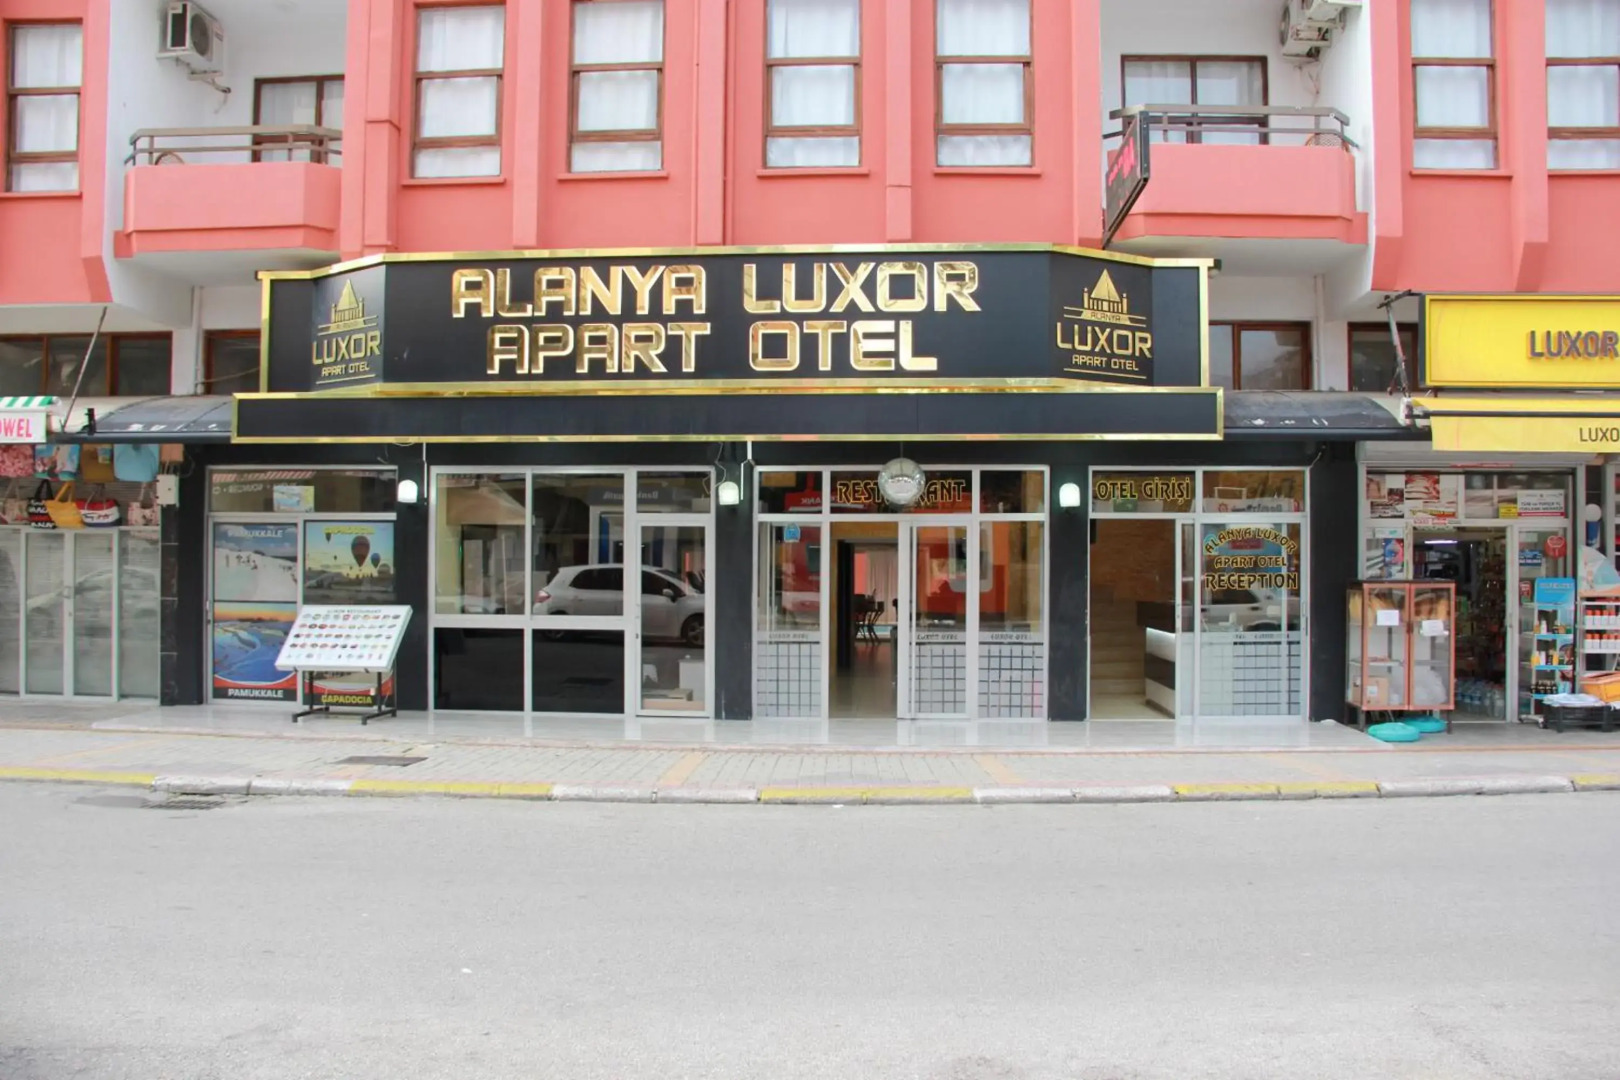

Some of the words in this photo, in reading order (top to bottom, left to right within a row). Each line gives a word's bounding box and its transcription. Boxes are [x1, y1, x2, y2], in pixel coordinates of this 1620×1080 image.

[452, 264, 706, 318] ALANYA
[743, 261, 982, 314] LUXOR
[312, 330, 381, 365] LUXOR
[486, 322, 711, 375] APART
[749, 320, 938, 371] OTEL
[1056, 322, 1152, 358] LUXOR
[1529, 330, 1620, 357] LUXOR
[321, 364, 346, 377] APART
[348, 361, 370, 374] OTEL
[1072, 354, 1108, 368] APART
[1110, 358, 1139, 371] OTEL
[836, 479, 966, 505] RESTANT
[1096, 480, 1138, 500] OTEL
[1141, 477, 1191, 505] GİRİŞİ
[1203, 527, 1252, 554] ALANYA
[1255, 527, 1298, 554] LUXOR
[1214, 555, 1256, 569] APART
[1257, 555, 1289, 568] OTEL
[1204, 571, 1299, 591] RECEPTION
[228, 688, 284, 698] PAMUKKALE
[321, 694, 373, 705] CAPADOCIA
